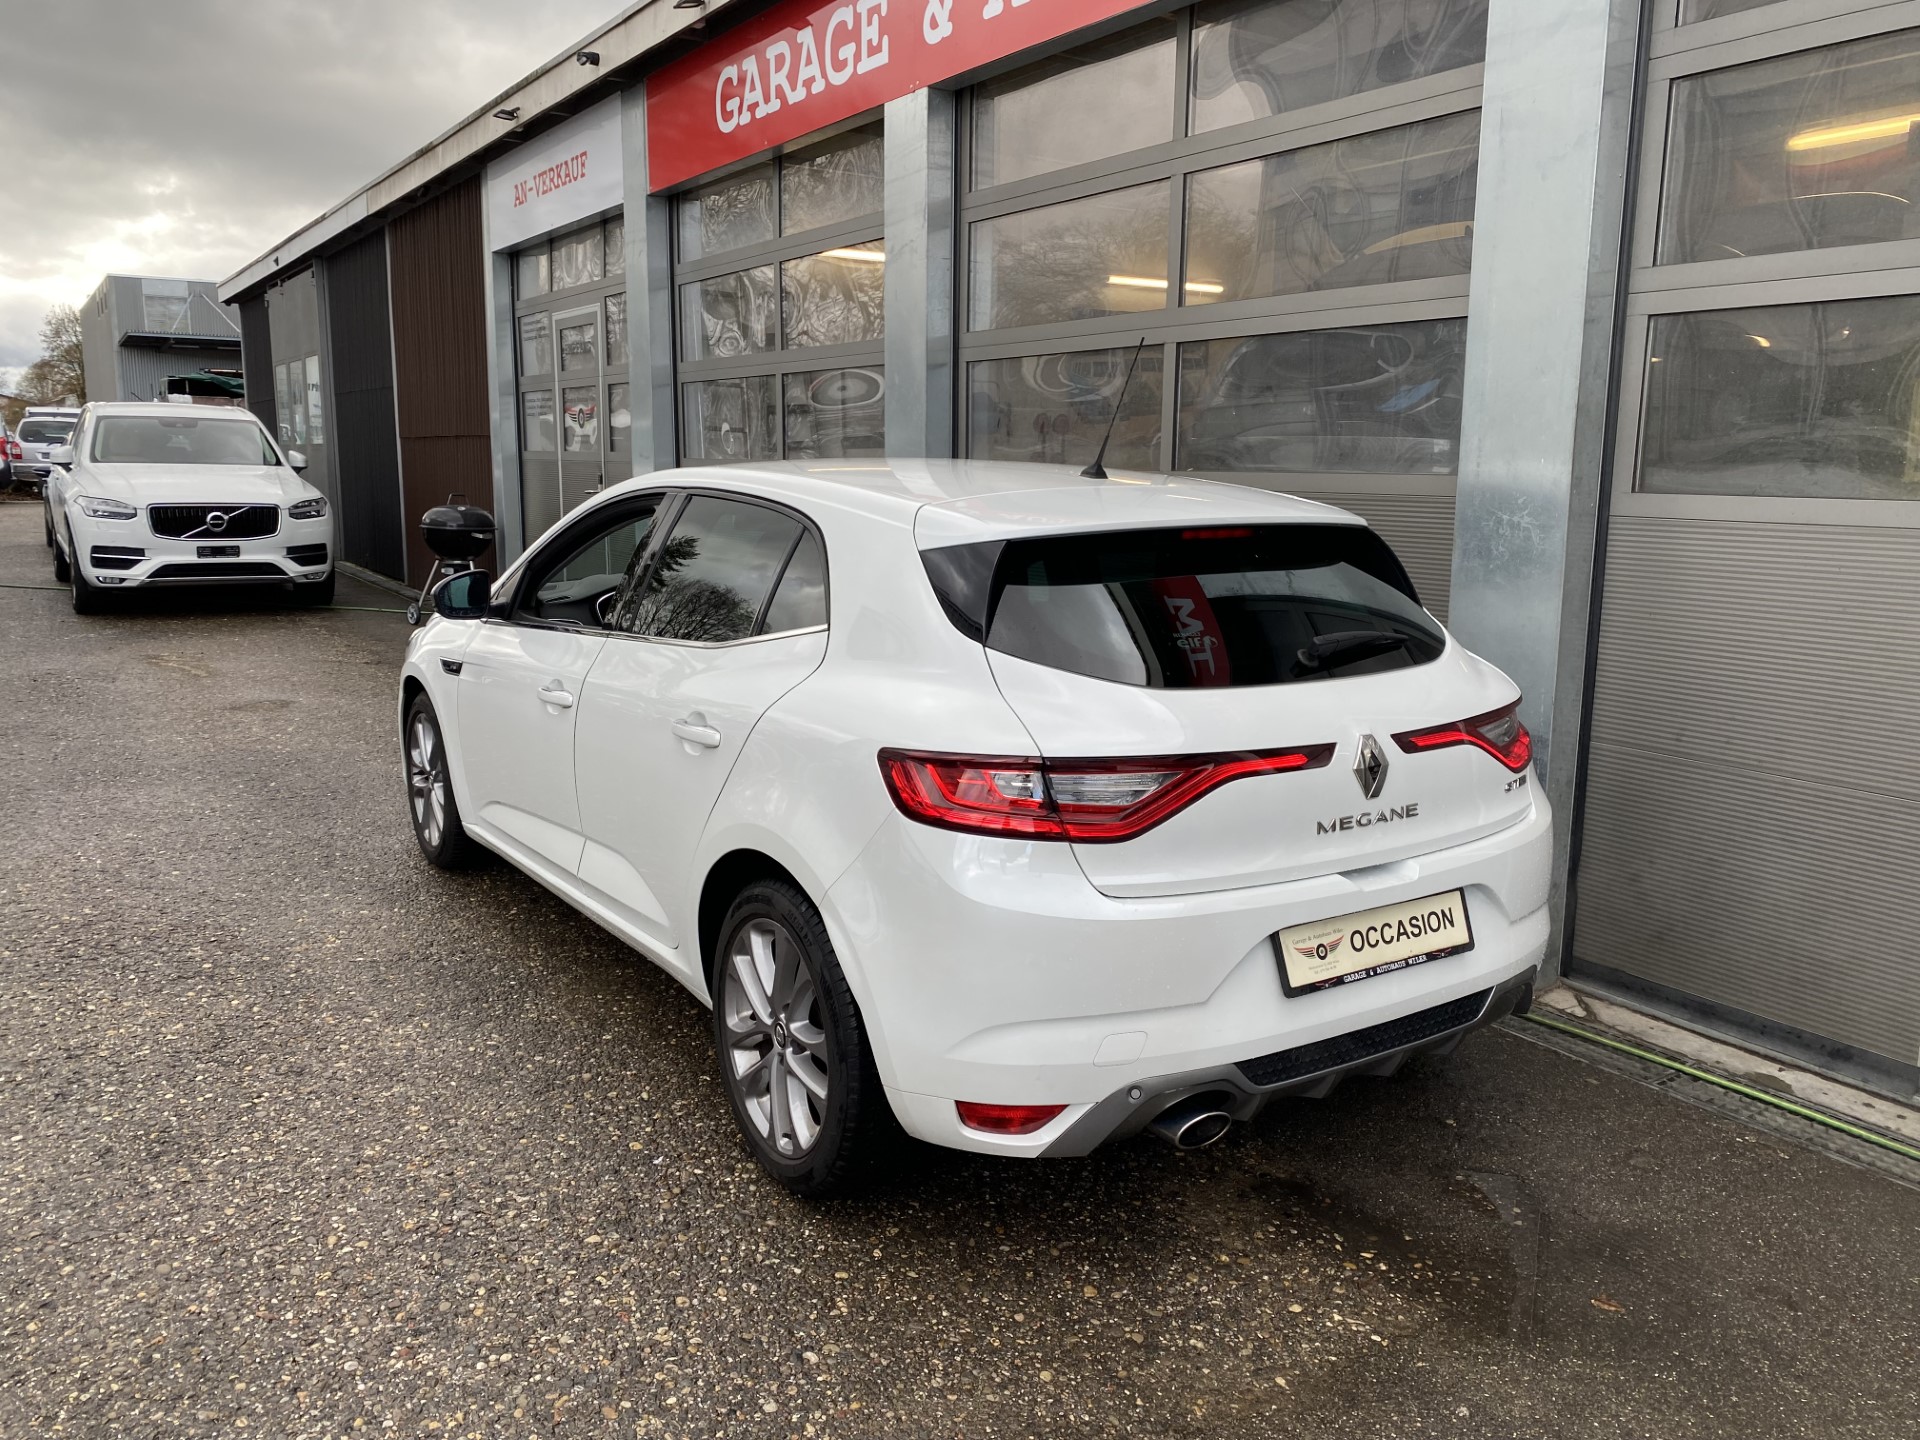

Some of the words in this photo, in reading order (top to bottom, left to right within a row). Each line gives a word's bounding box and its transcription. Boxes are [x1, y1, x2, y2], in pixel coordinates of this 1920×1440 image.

[716, 0, 889, 133] GARAGE
[514, 150, 587, 208] AN-VERKAUF
[1316, 803, 1419, 835] MEGANE
[1350, 907, 1455, 952] OCCASION
[1343, 971, 1367, 982] GARAGE
[1377, 961, 1406, 974] AUTOHAUS
[1408, 955, 1428, 965] WILER
